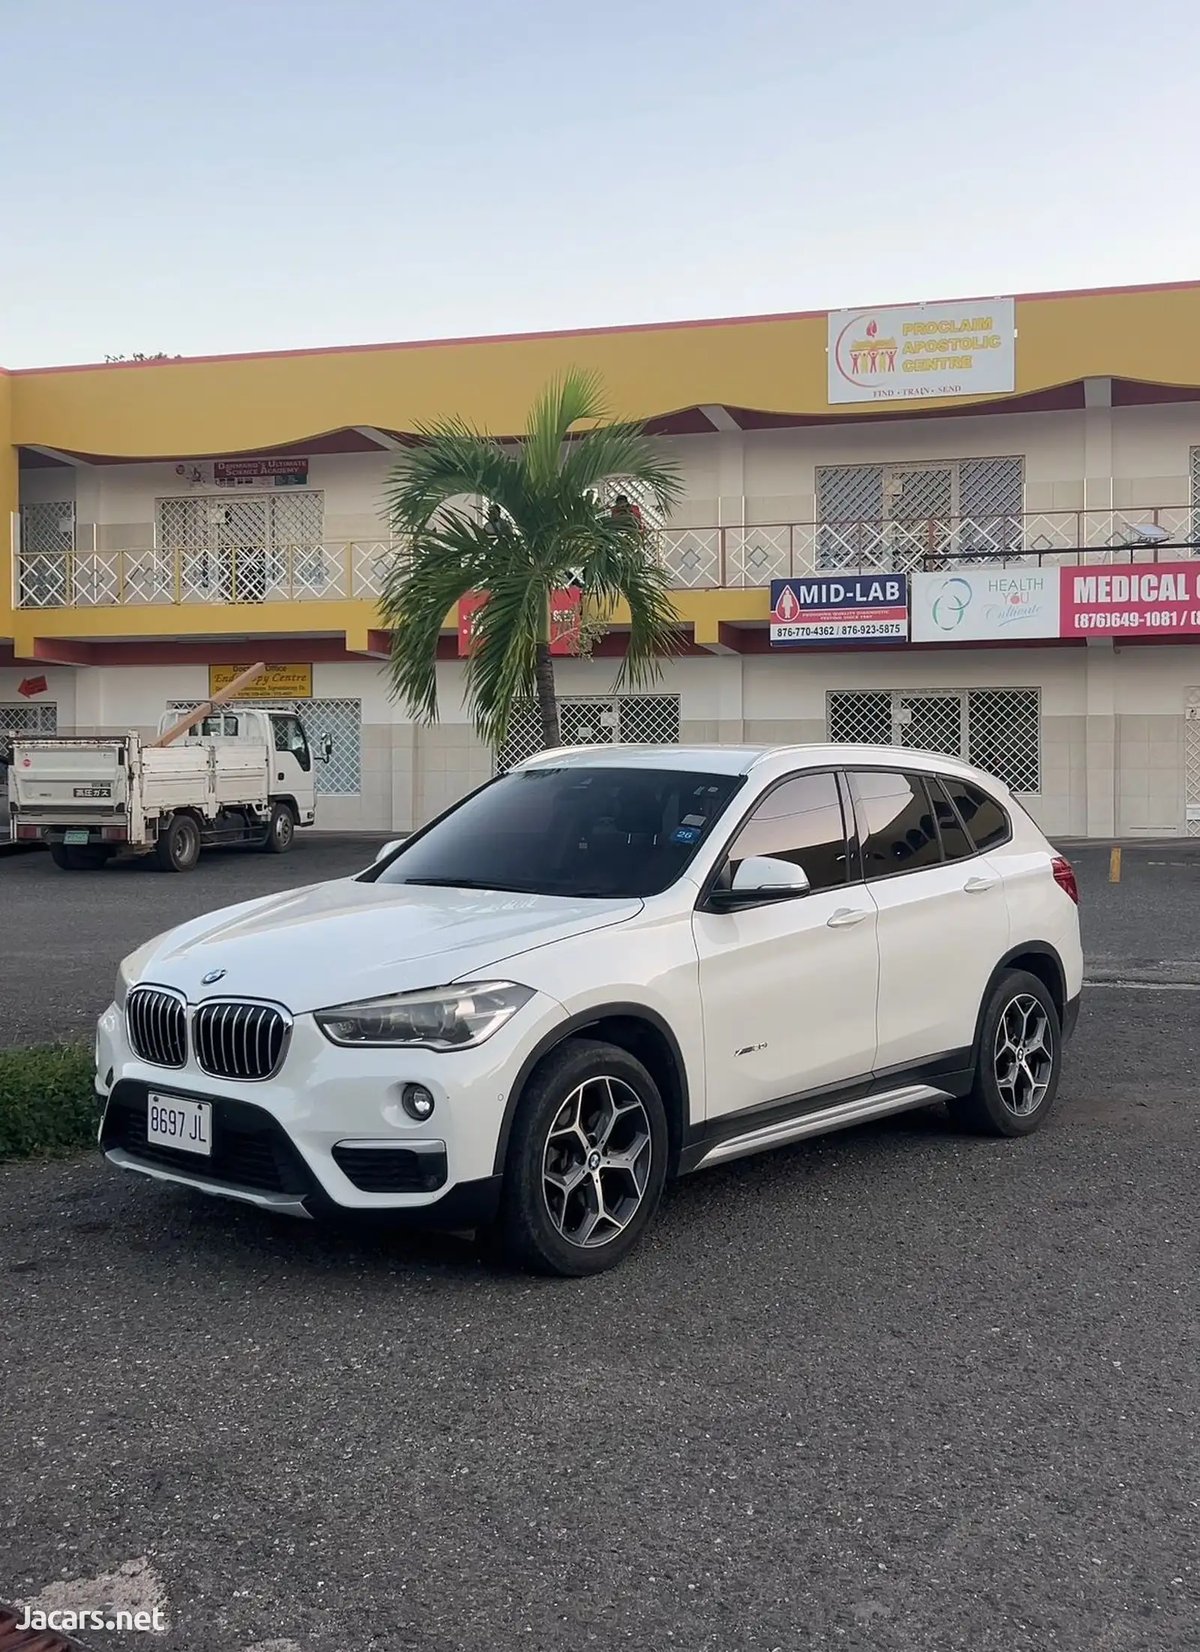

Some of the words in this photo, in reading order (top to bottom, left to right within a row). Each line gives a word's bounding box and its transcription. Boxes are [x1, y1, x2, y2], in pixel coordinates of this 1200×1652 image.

[903, 317, 992, 336] PROCLAIM
[902, 336, 1001, 355] APOSTOLIC
[903, 355, 972, 373] CENTRE
[873, 389, 894, 398] FIND
[903, 387, 931, 396] TRAIN
[938, 385, 962, 394] SEND
[225, 467, 258, 476] SCIENCE
[260, 466, 300, 475] ACADEMY
[268, 459, 307, 468] ULTIMATE
[800, 582, 900, 604] MID-LAB
[988, 578, 1043, 592] HEALTH
[1074, 573, 1190, 604] MEDICAL
[1002, 592, 1029, 605] YOU
[1074, 610, 1177, 628] (876)649-1081
[777, 625, 834, 637] 876-770-4362
[841, 624, 900, 635] 876-923-5875
[271, 673, 306, 682] Centre
[151, 1106, 185, 1138] 8697
[189, 1114, 207, 1143] JL
